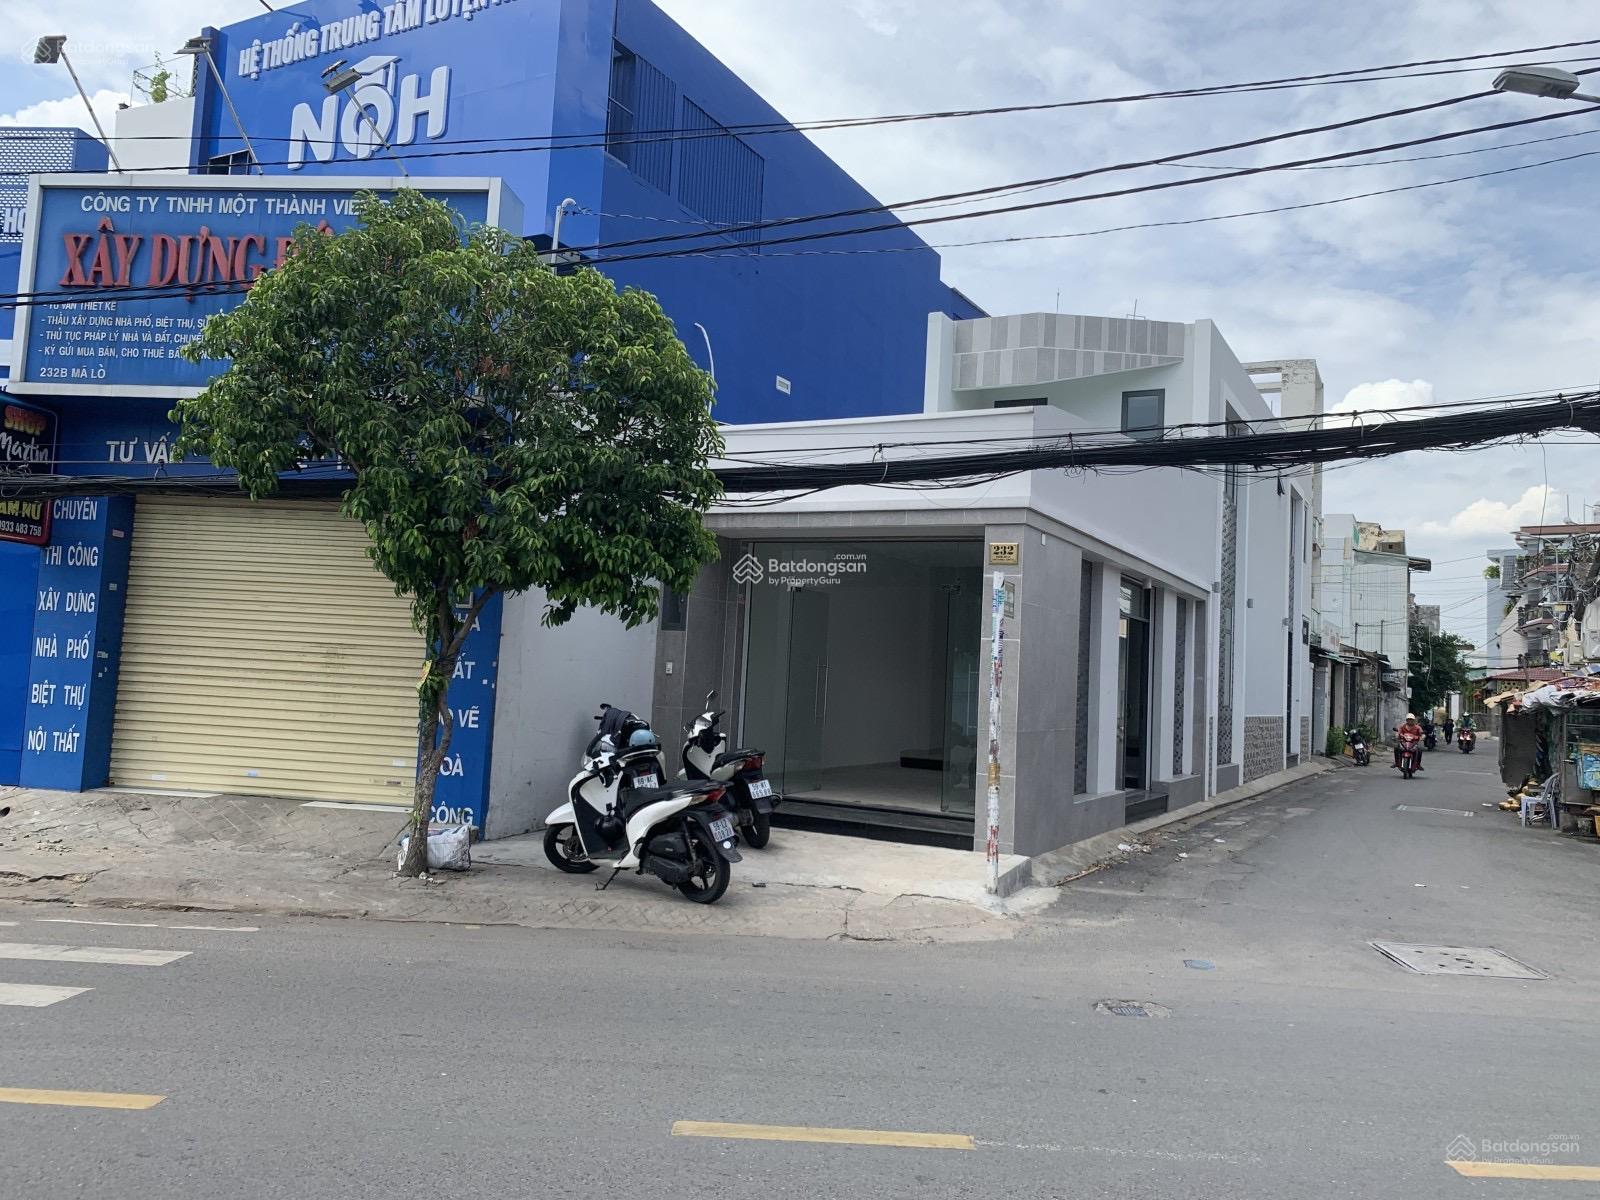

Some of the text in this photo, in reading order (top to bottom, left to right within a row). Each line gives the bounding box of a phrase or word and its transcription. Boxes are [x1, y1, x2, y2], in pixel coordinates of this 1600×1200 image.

[238, 39, 261, 80] HỆ
[262, 22, 320, 70] THỐNG
[320, 11, 381, 54] TRUNG
[81, 192, 131, 212] CÔNG
[136, 196, 160, 213] TY
[166, 197, 213, 214] TNHH
[218, 193, 258, 217] MỘT
[264, 194, 326, 216] THÀNH
[58, 216, 144, 287] XÂY
[147, 226, 266, 303] DỰNG
[71, 314, 87, 326] XÂY
[115, 315, 132, 327] NHÀ
[155, 316, 174, 330] BIỆT
[84, 330, 106, 342] PHÁP
[109, 329, 119, 342] LÝ
[122, 330, 139, 342] NHÀ
[142, 331, 153, 342] VÀ
[44, 344, 56, 356] KÝ
[77, 346, 95, 356] MUA
[121, 348, 139, 358] CHO
[143, 346, 164, 358] THUÊ
[40, 364, 106, 379] 232B MÃ LÒ
[5, 405, 46, 435] SHOP
[0, 431, 49, 464] Martin
[106, 436, 138, 463] TƯ
[53, 496, 97, 521] CHUYÊN
[15, 522, 28, 535] 483
[29, 524, 42, 537] 758
[45, 541, 98, 567] THI CÔNG
[993, 545, 1014, 556] 232
[38, 587, 95, 617] XÂY DỰNG
[35, 630, 92, 660] NHÀ PHỐ
[31, 679, 87, 710] BIỆT THỰ
[458, 705, 480, 728] VẼ
[28, 723, 80, 755] NỘI THẤT
